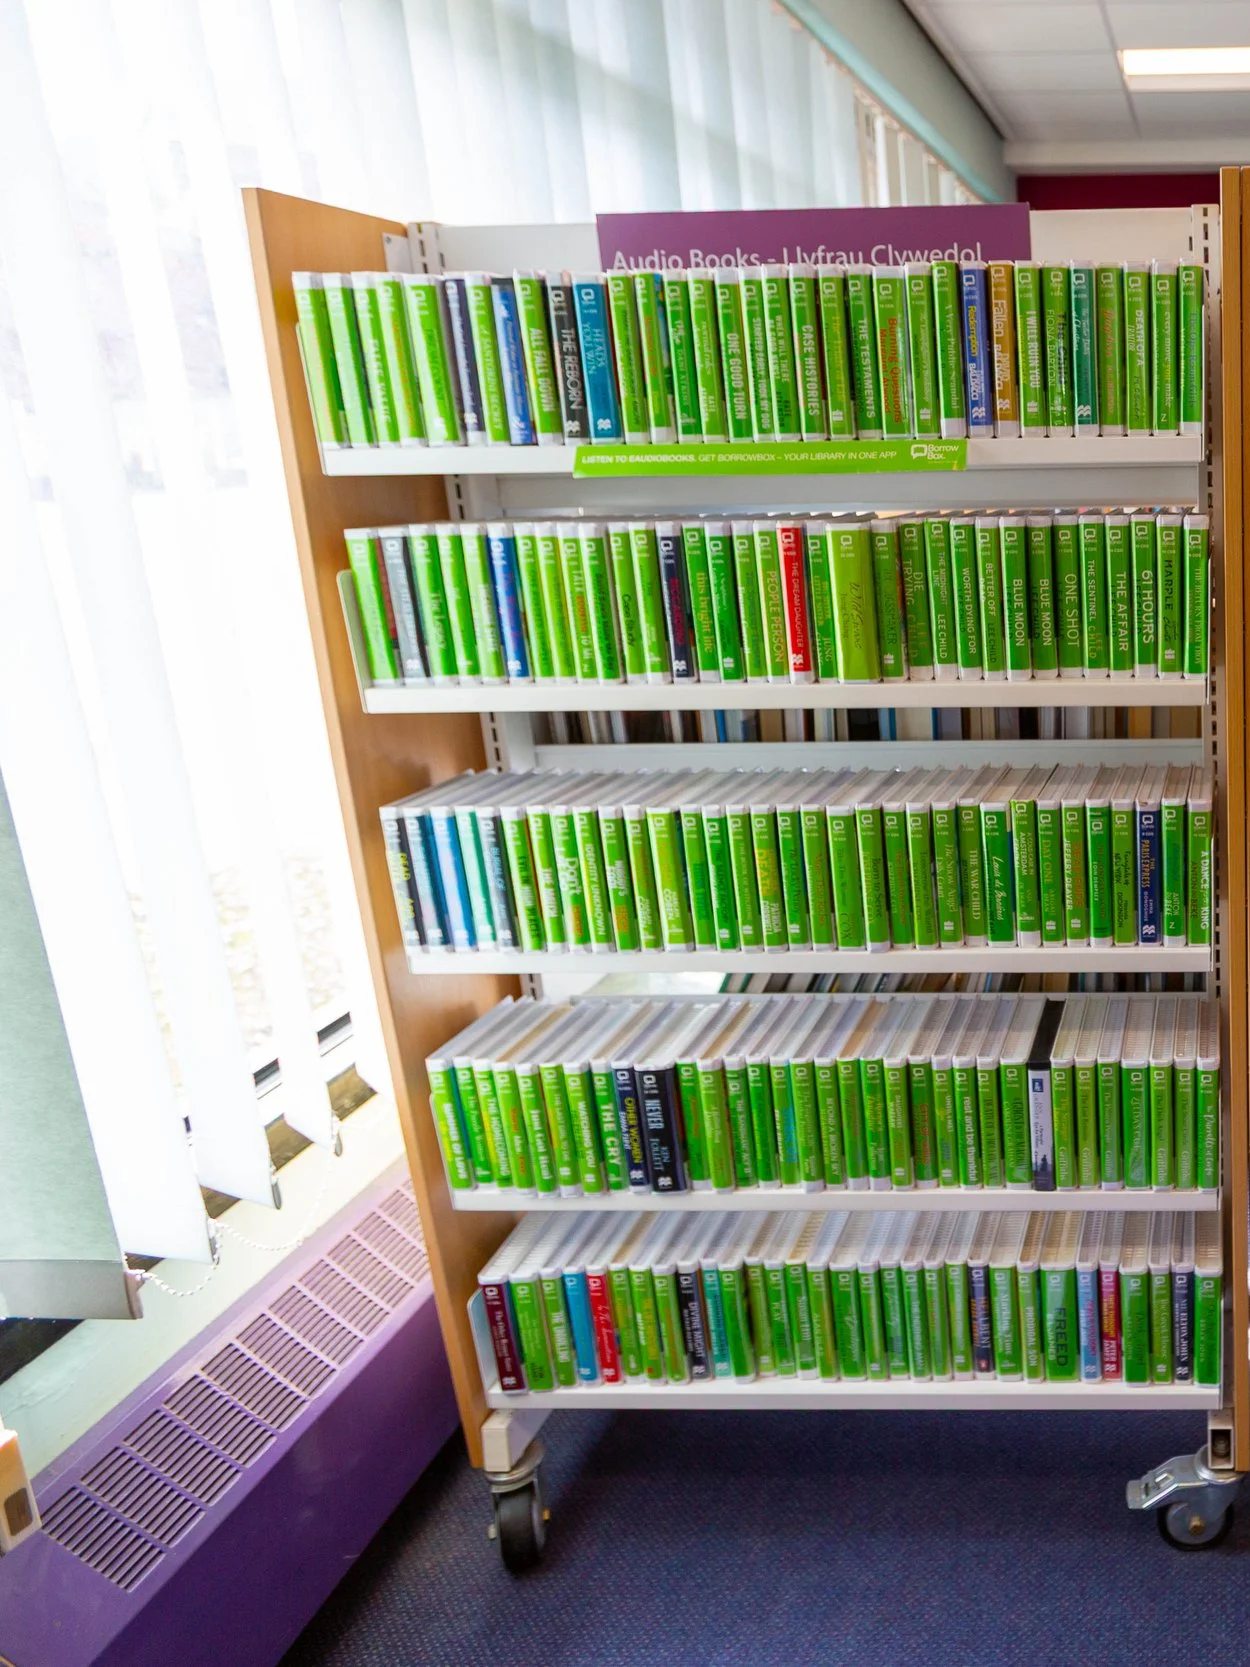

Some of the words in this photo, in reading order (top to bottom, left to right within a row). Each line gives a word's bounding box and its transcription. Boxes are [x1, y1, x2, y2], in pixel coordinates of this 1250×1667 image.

[613, 248, 684, 269] Audio
[690, 247, 760, 268] Books
[872, 242, 982, 265] Clywedol
[858, 320, 868, 343] THE
[968, 306, 979, 357] Redemption
[992, 300, 1006, 338] Fallen
[530, 328, 544, 348] ALL
[561, 328, 576, 354] THE
[727, 333, 738, 357] ONE
[803, 325, 815, 354] CASE
[886, 318, 899, 363] Burning
[534, 351, 549, 377] FALL
[730, 359, 743, 389] GOOD
[538, 378, 556, 412] DOWN
[563, 356, 584, 411] REBORN
[805, 358, 820, 417] HISTORIES
[860, 346, 875, 419] TESTAMENTS
[890, 368, 903, 424] Questions
[733, 391, 747, 420] TURN
[582, 456, 612, 464] LISTEN
[614, 456, 627, 464] TO
[698, 454, 716, 462] GET
[718, 453, 776, 462] BORROWBOX
[785, 453, 809, 461] YOUR
[810, 452, 847, 460] LIBRARY
[859, 452, 878, 460] ONE
[879, 451, 897, 459] APP
[928, 444, 959, 453] Borrow
[902, 560, 915, 606] TRYING
[913, 572, 925, 592] DIE
[986, 563, 995, 597] BETTER
[1088, 560, 1096, 576] THE
[1142, 570, 1154, 585] 61
[766, 570, 781, 613] PEOPLE
[962, 567, 972, 601] WORTH
[1013, 579, 1024, 609] BLUE
[1065, 574, 1078, 603] ONE
[1116, 571, 1127, 596] THE
[1165, 560, 1174, 610] MARPLE
[988, 600, 997, 617] OFF
[1088, 579, 1098, 621] SENTINEL
[964, 604, 975, 633] DYING
[1014, 612, 1026, 646] MOON
[1067, 608, 1081, 648] SHOT
[1117, 604, 1130, 651] AFFAIR
[1143, 590, 1155, 644] HOURS
[770, 616, 785, 662] PERSON
[939, 632, 948, 659] CHILD
[967, 635, 977, 654] FOR
[600, 1103, 615, 1133] THE
[644, 1099, 665, 1130] NEVER
[963, 1097, 973, 1114] rest
[965, 1117, 975, 1132] and
[966, 1134, 976, 1145] be
[606, 1137, 622, 1166] CRY
[966, 1147, 979, 1182] thankful
[1055, 1308, 1070, 1367] FREED
